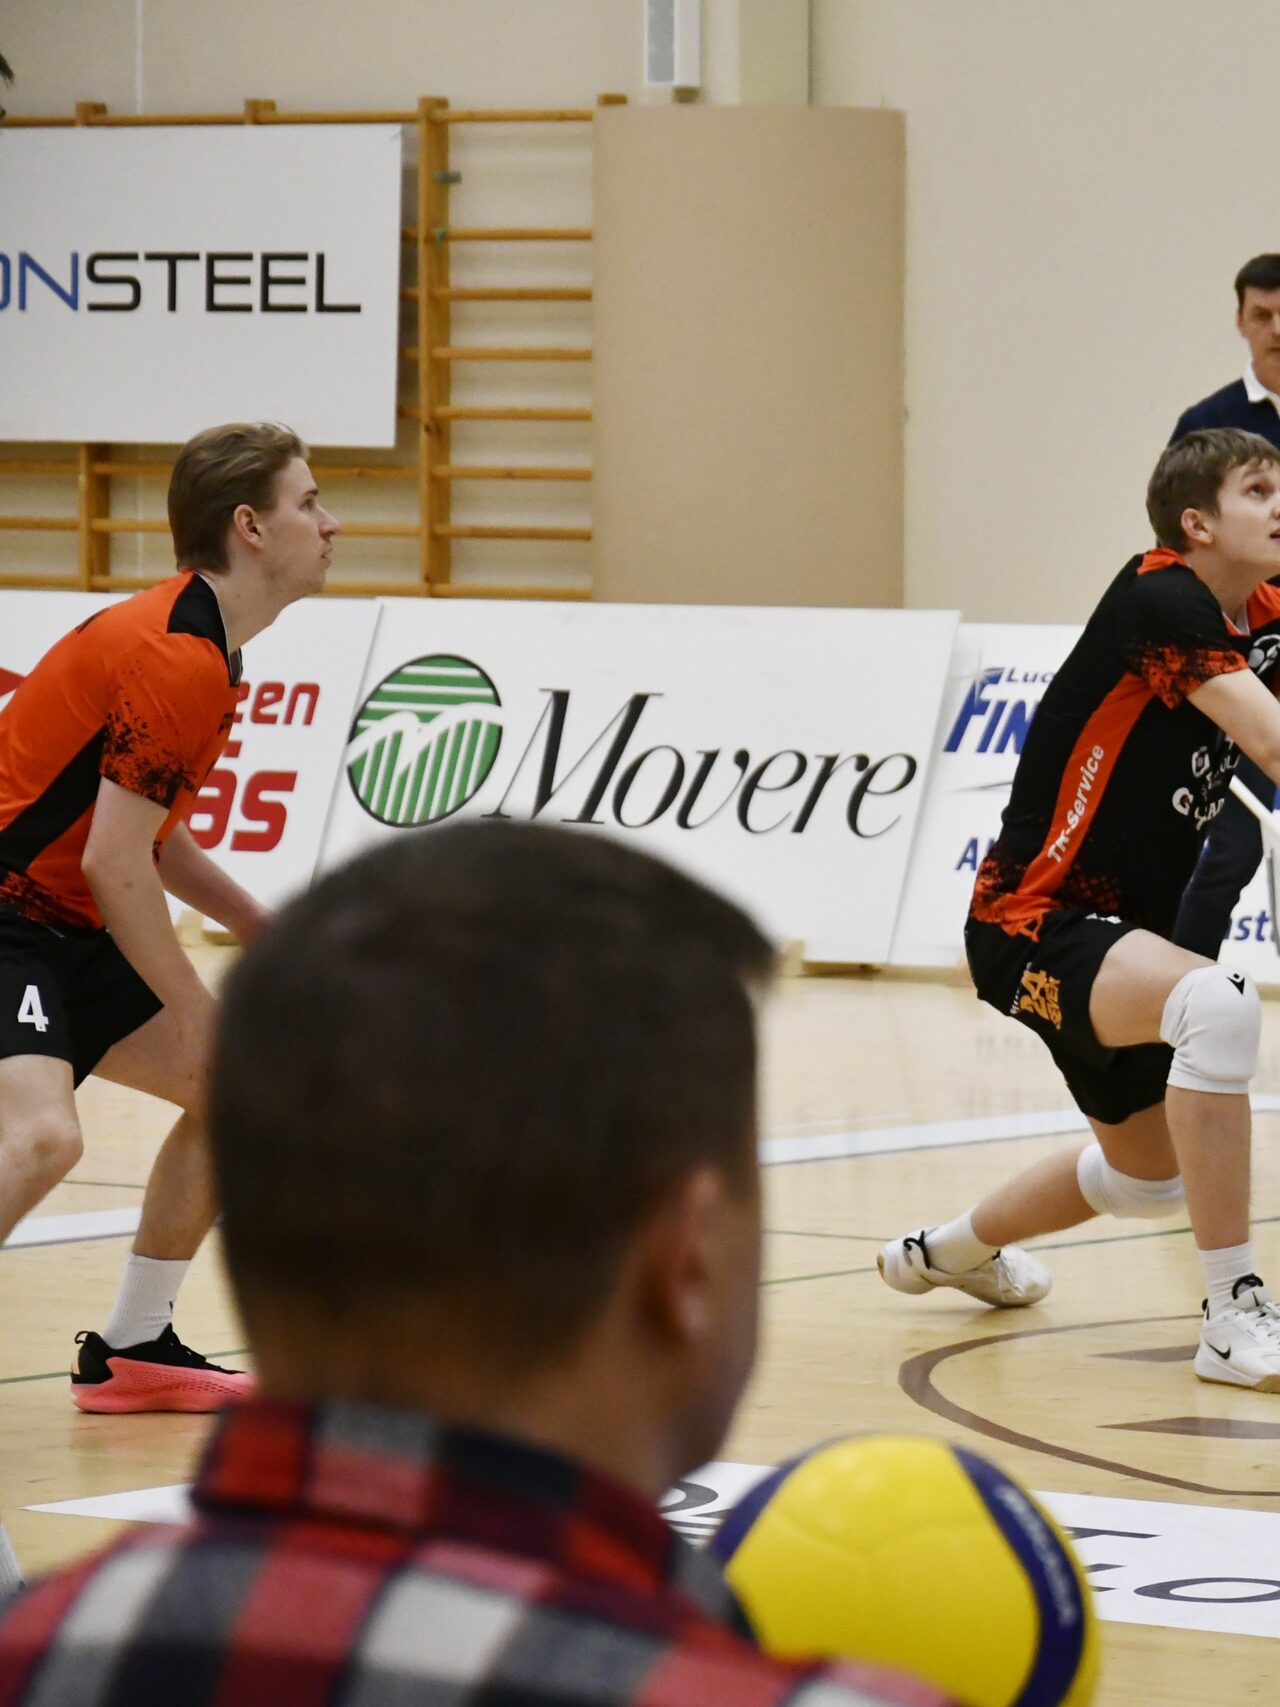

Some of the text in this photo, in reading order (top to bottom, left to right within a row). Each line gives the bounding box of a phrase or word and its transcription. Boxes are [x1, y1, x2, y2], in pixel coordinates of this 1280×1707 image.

[0, 252, 361, 313] NSTEEL
[481, 688, 917, 838] Movere
[17, 984, 49, 1032] 4
